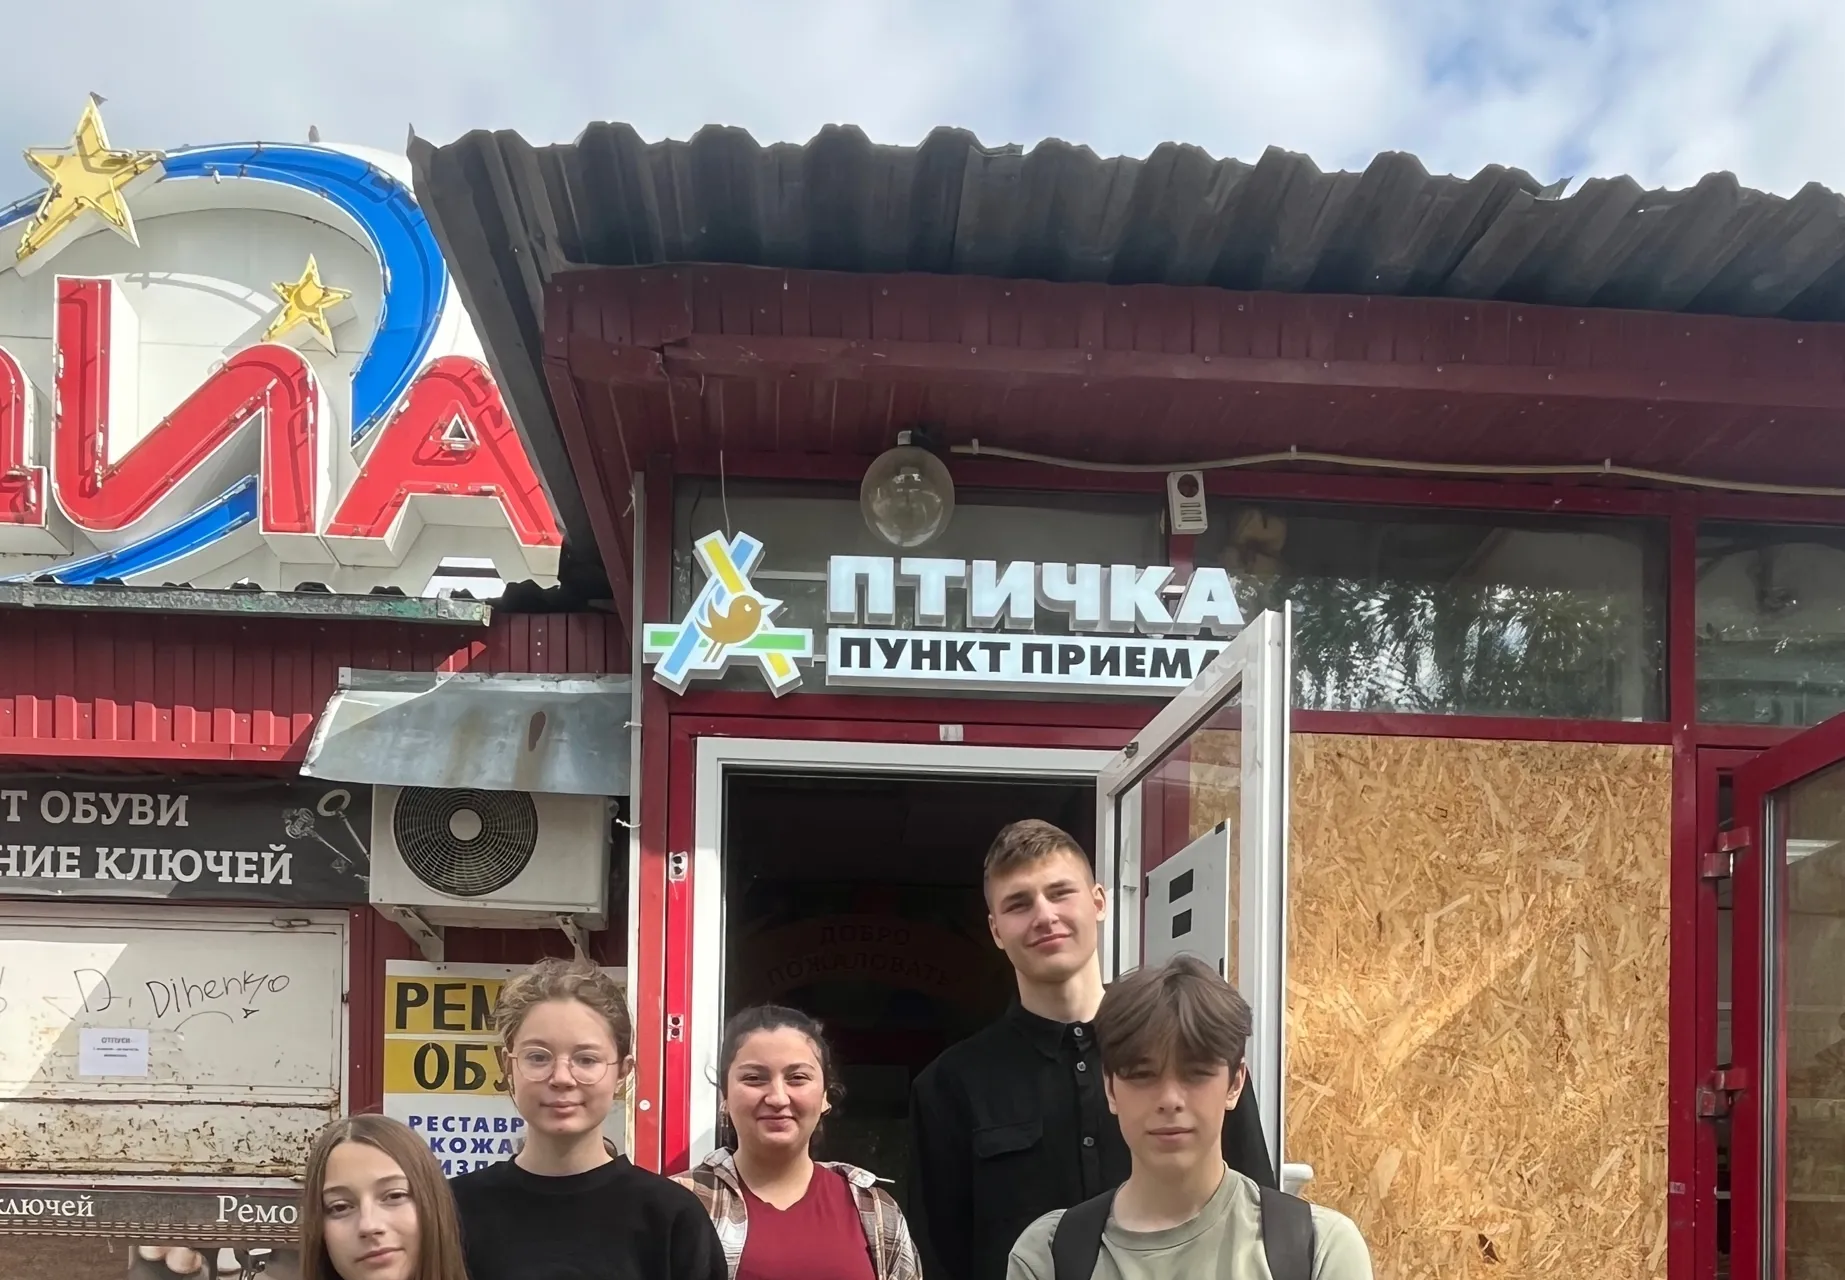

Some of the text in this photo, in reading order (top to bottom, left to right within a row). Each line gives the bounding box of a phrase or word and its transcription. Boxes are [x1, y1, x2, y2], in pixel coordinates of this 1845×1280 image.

[0, 274, 564, 547] ИА
[829, 554, 1245, 627] ПТИЧКА
[840, 637, 1011, 673] ПУНКТ
[40, 790, 189, 827] ОБУВИ
[95, 844, 293, 885] КЛЮЧЕЙ
[819, 923, 911, 946] ДОБРО
[408, 1115, 525, 1134] РЕСТАВР
[430, 1136, 524, 1155] КОЖА
[215, 1195, 298, 1224] Ремо
